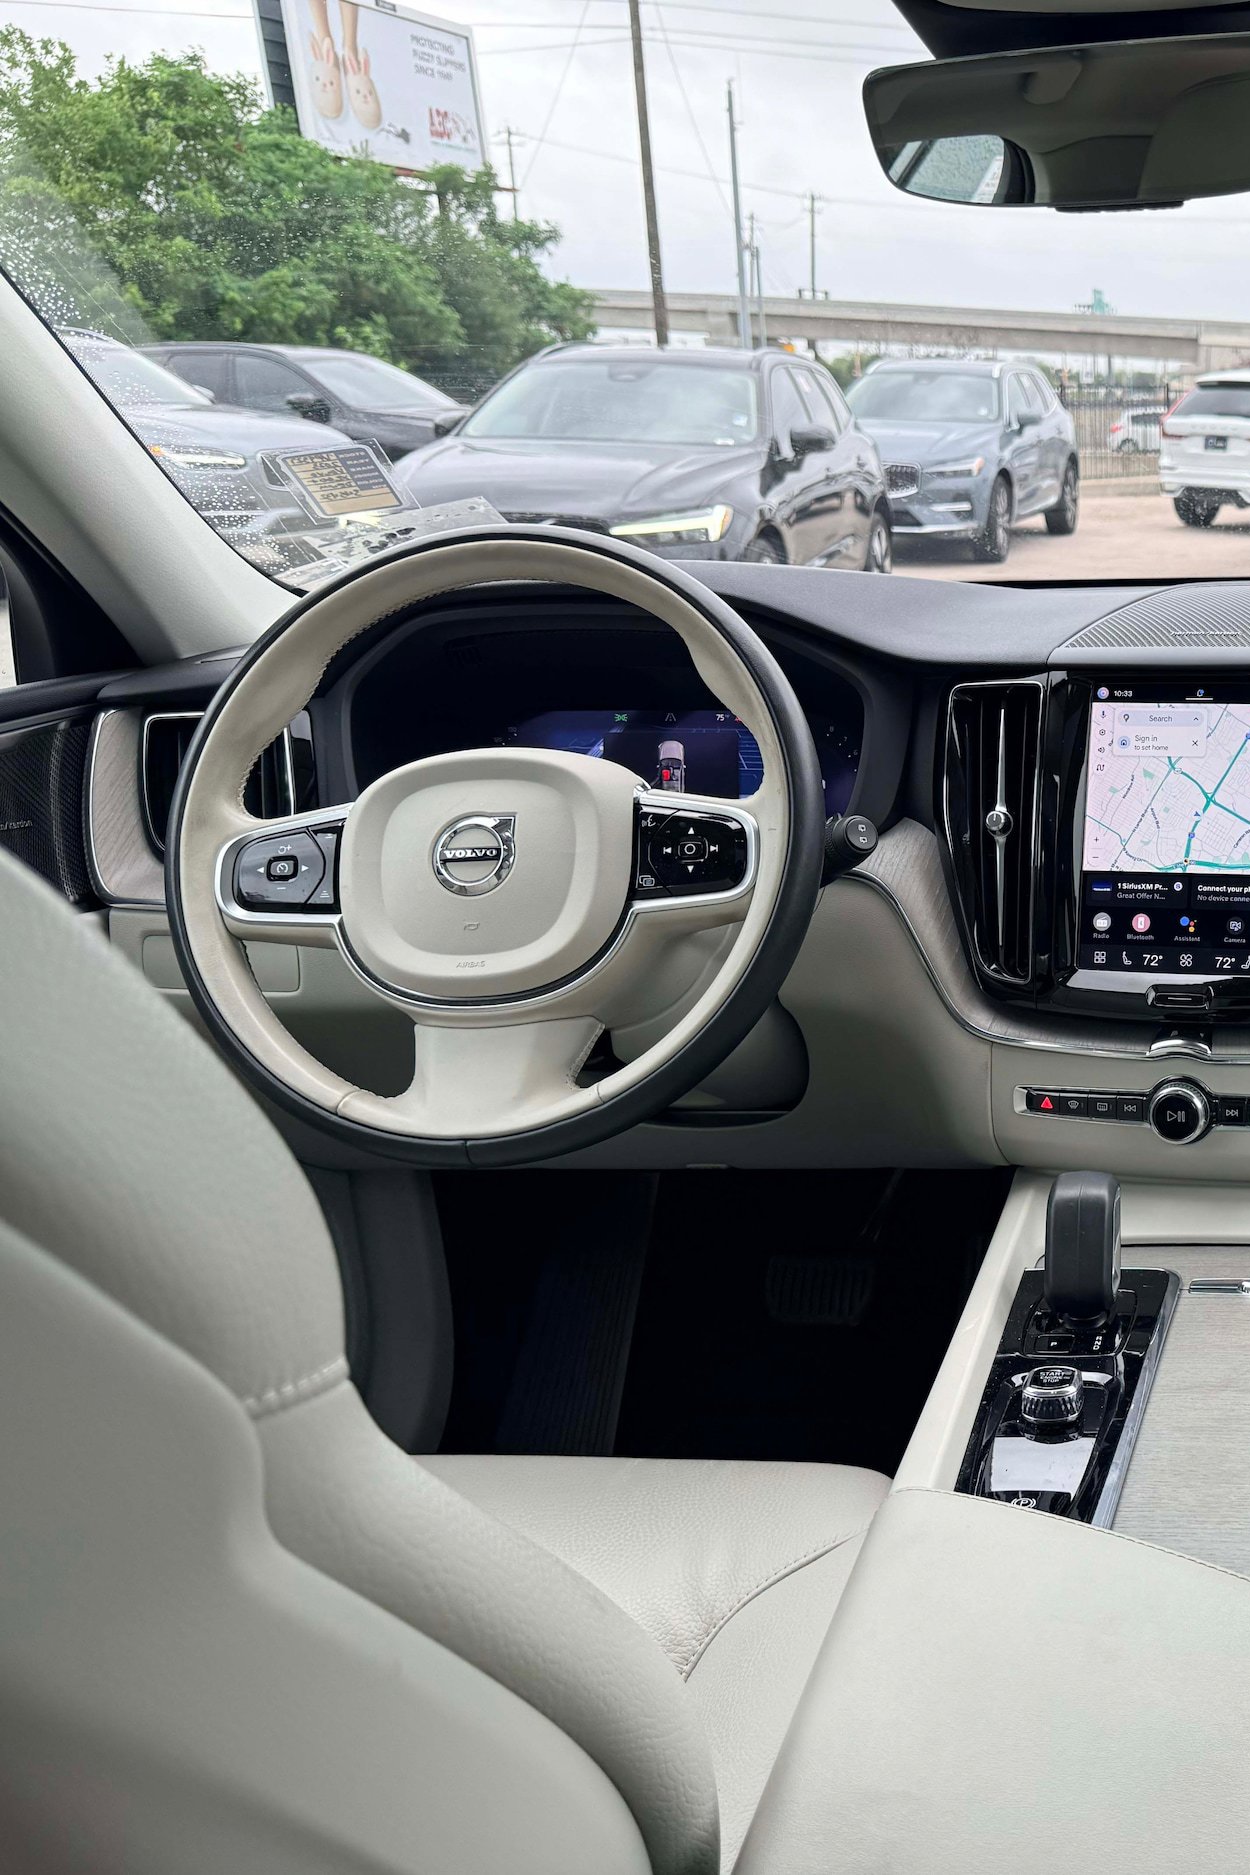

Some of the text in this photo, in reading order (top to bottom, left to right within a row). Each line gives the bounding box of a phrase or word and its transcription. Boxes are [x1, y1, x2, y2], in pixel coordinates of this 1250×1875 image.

[1134, 734, 1149, 743] Sign
[443, 848, 498, 858] VOLVO
[456, 961, 486, 969] AIRBAG
[1142, 954, 1163, 967] 72°
[1215, 956, 1236, 969] 72°
